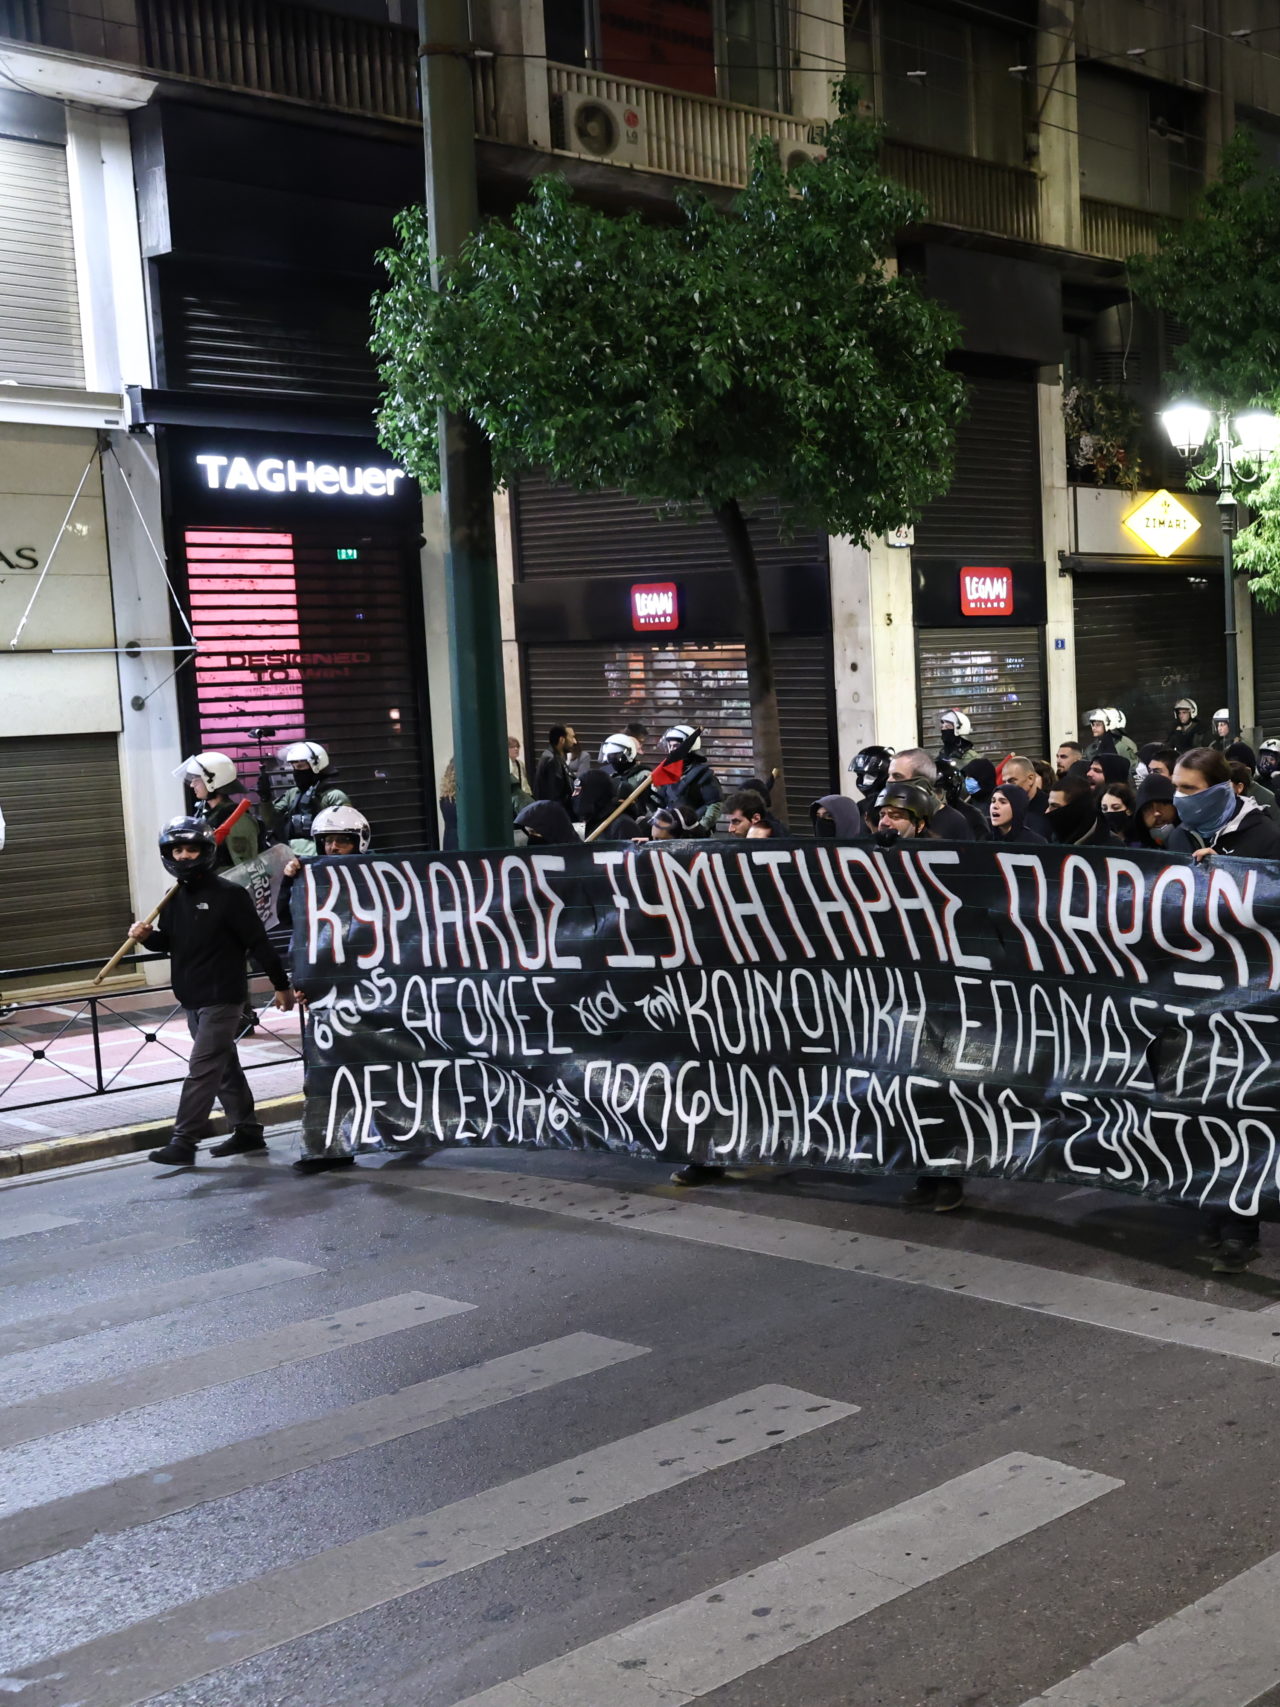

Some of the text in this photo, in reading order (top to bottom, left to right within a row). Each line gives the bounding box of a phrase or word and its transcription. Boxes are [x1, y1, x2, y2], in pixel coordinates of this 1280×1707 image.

[1144, 517, 1187, 530] ZIMARI
[969, 601, 1006, 609] MILANO
[885, 613, 893, 626] 3
[226, 652, 371, 668] DESIGNED
[250, 668, 289, 682] TO
[305, 855, 582, 971] ΚΥΡΙΑΚΟΣ
[592, 847, 992, 971] ΞΥΜΗΤΗΡΗΣ
[584, 1059, 1041, 1172] ΠΡΟΦΥΛΑΚΙΣΜΕΝΑ
